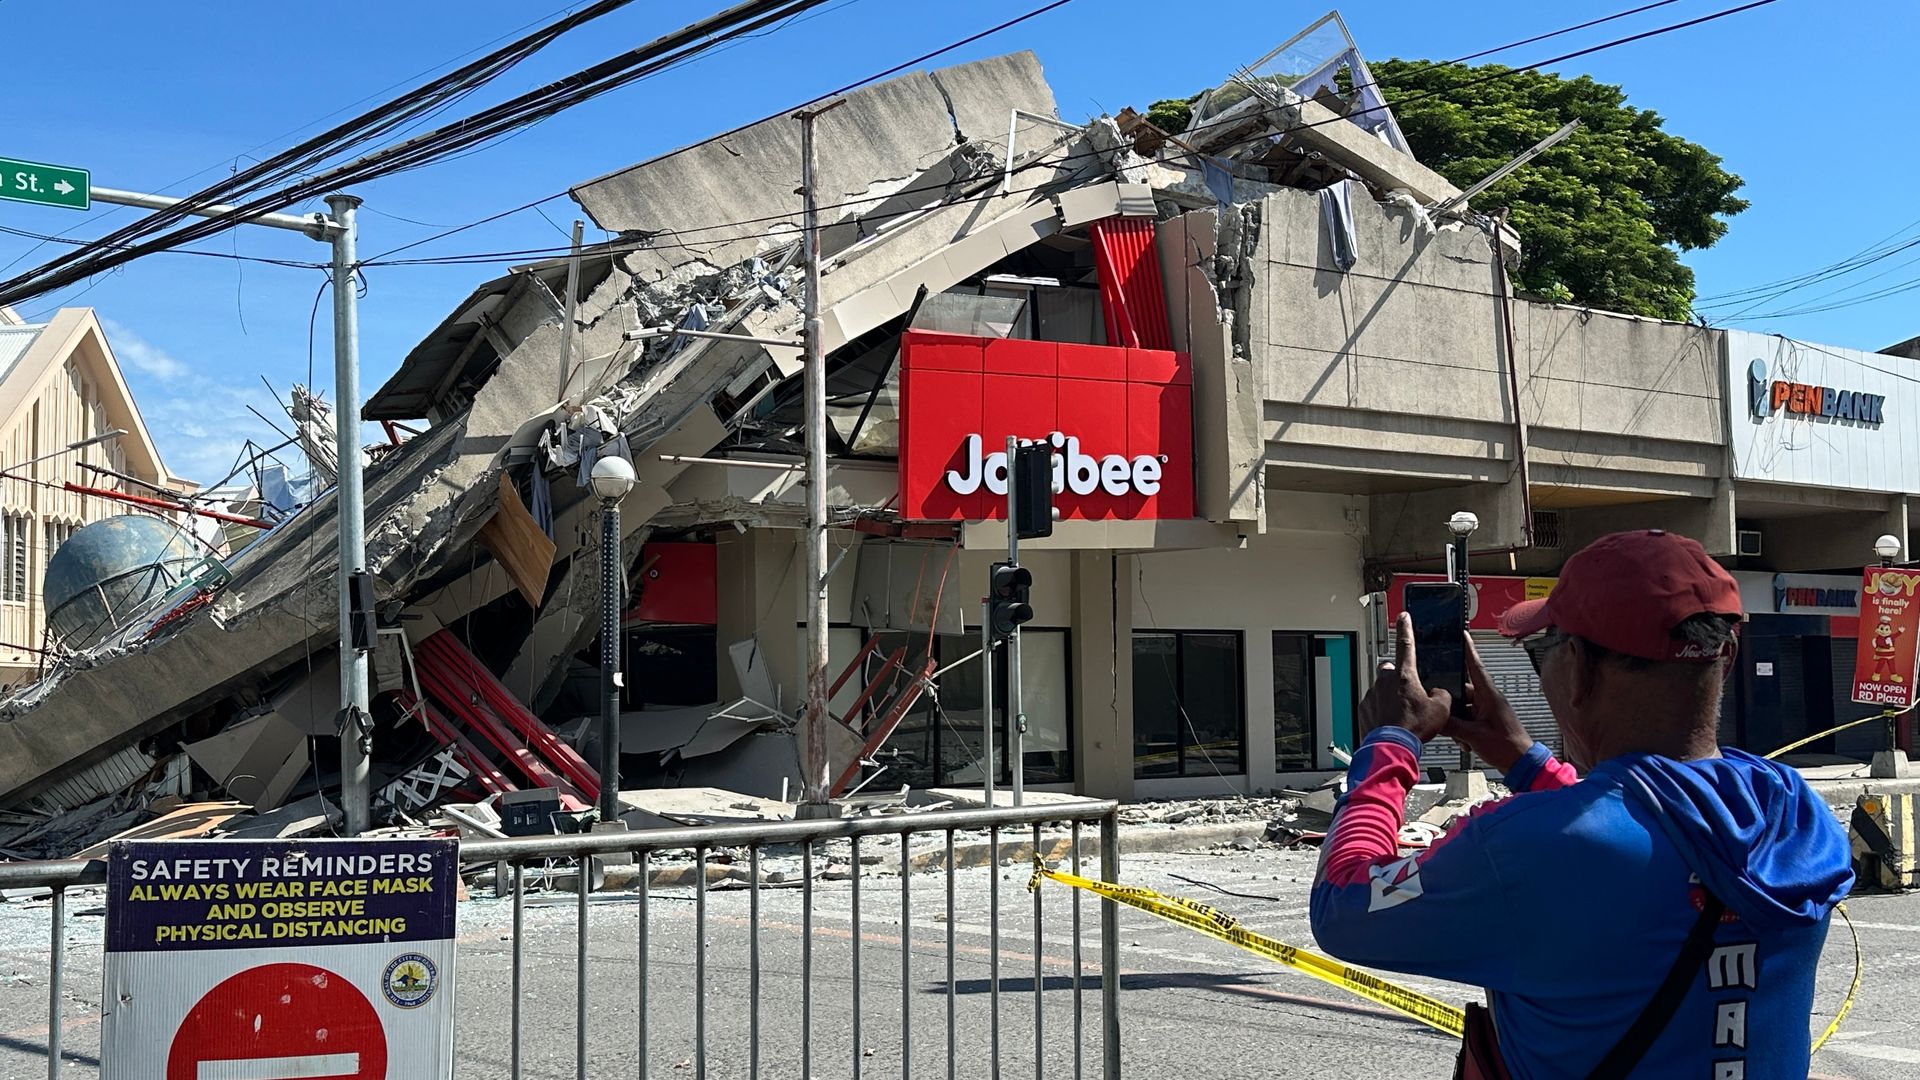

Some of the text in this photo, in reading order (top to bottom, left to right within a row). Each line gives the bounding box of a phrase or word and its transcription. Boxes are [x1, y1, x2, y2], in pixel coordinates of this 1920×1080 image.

[15, 171, 45, 193] St.
[1772, 380, 1885, 423] PENBANK
[947, 431, 1163, 496] Joibee
[1872, 597, 1910, 609] is finally
[1858, 690, 1906, 705] RD Plaza
[1859, 682, 1907, 694] NOW OPEN
[131, 853, 433, 880] SAFETY REMINDERS
[128, 877, 434, 902] ALWAYS WEAR FACE MASK
[206, 900, 365, 921] AND OBSERVE
[155, 917, 407, 942] PHYSICAL DISTANCING
